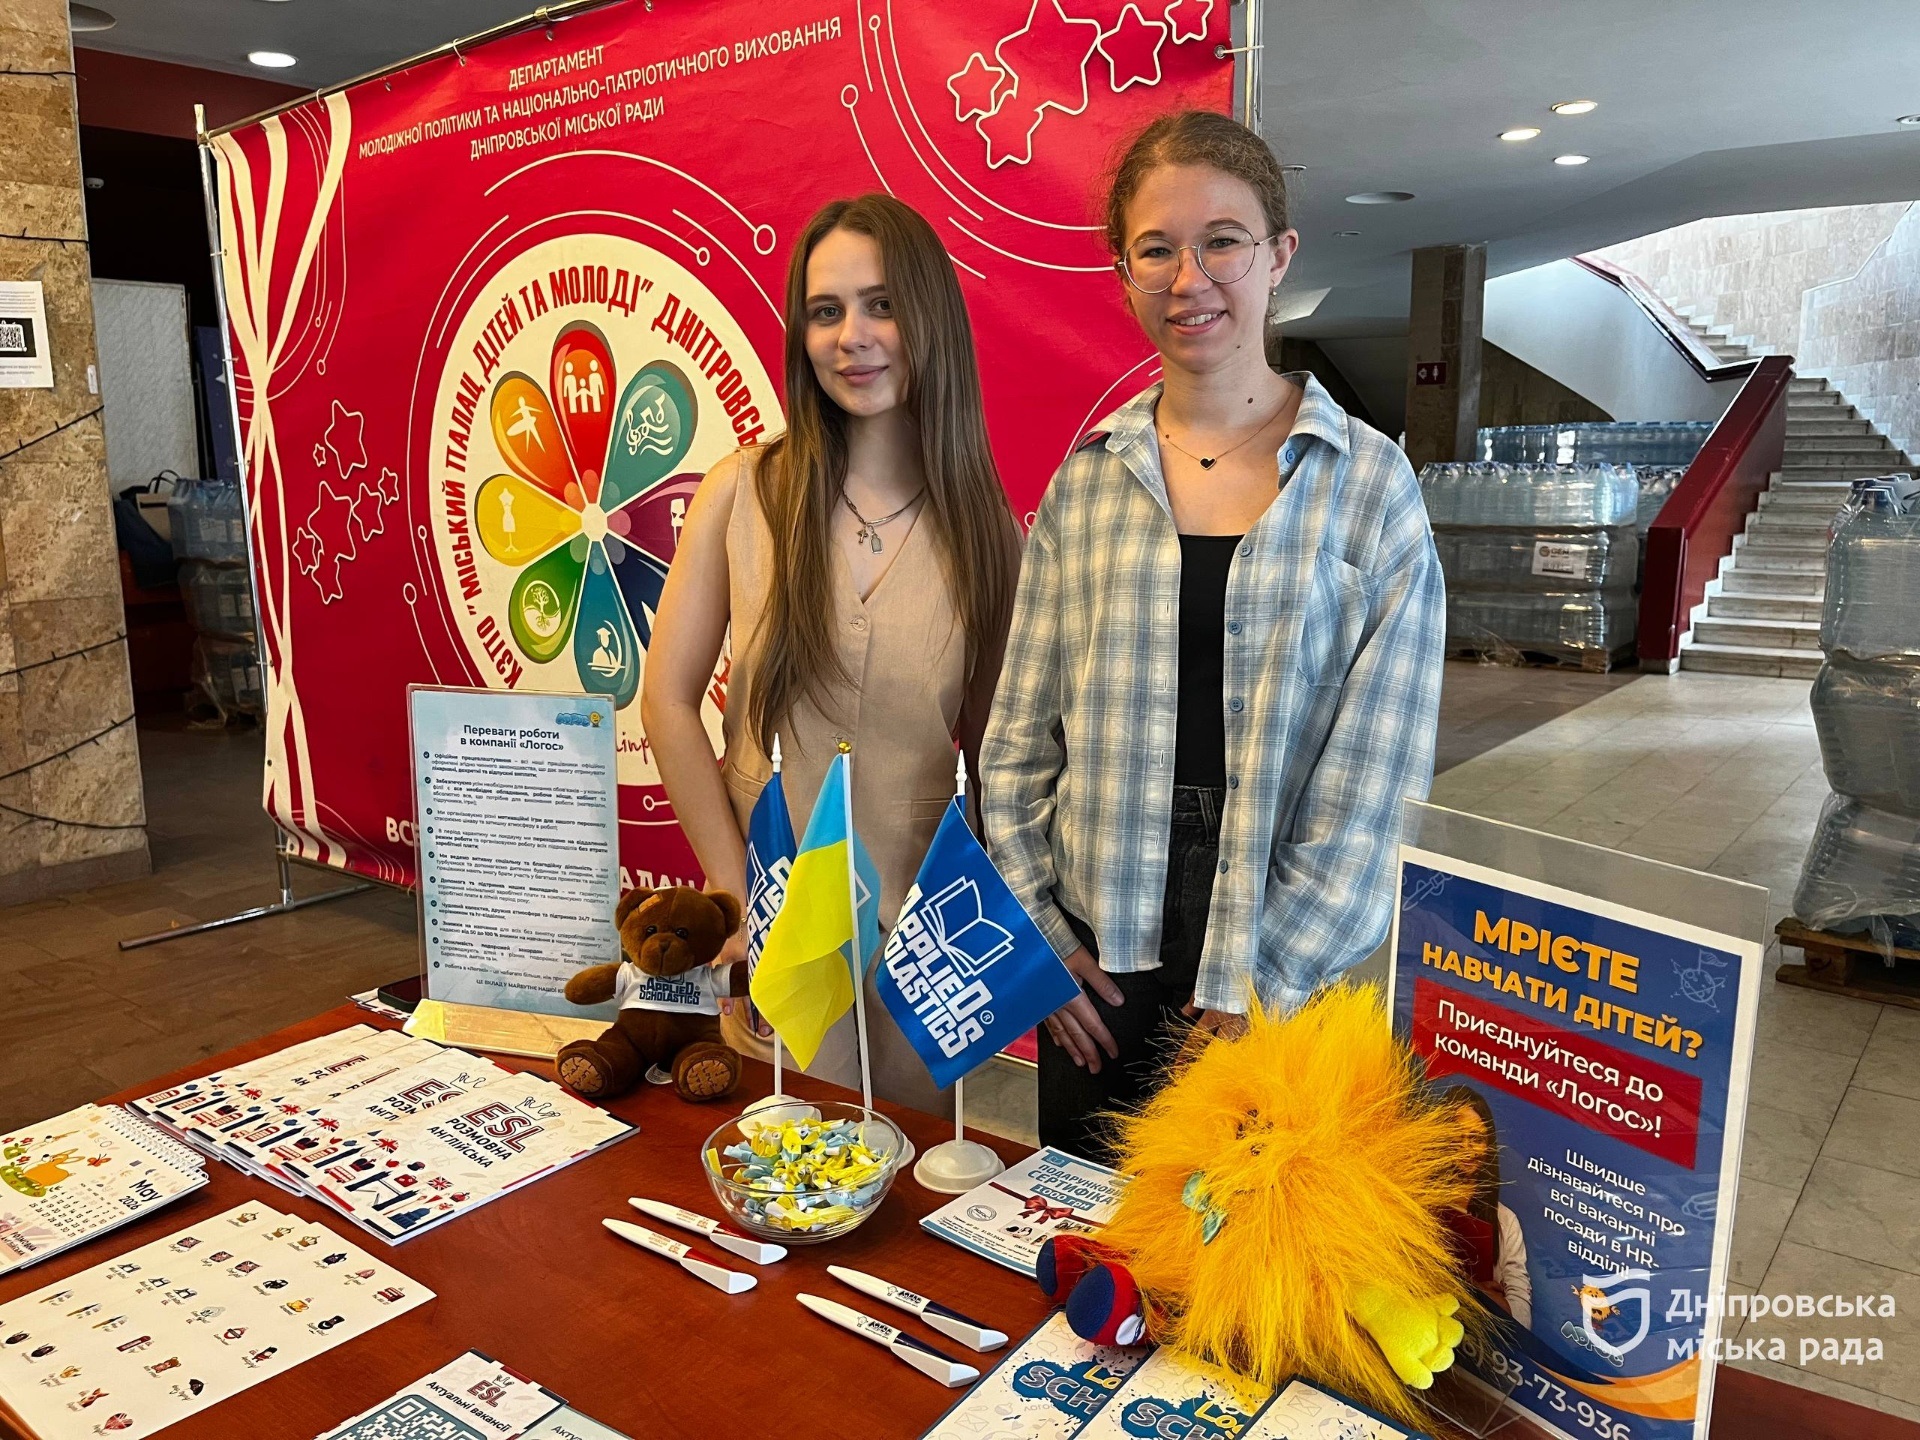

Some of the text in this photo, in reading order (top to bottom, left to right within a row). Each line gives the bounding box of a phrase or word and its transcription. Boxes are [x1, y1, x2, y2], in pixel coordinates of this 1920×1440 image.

[358, 16, 842, 160] МОЛОДІЖНОЇ ПОЛІТИКИ ТА НАЦІОНАЛЬНО-ПАТРІОТИЧНОГО ВИХОВАННЯ
[508, 45, 604, 91] ДЕПАРТАМЕНТ
[470, 96, 665, 162] ДНІПРОВСЬКОЇ МІСЬКОЇ РАДИ
[446, 372, 485, 473] ПАЛАЦ
[473, 293, 523, 385] ДІТЕЙ
[519, 279, 549, 322] ТА
[651, 293, 767, 448] ДНІПРОВСЬ
[463, 724, 560, 740] Переваги роботи
[469, 738, 517, 748] компанії
[519, 740, 564, 751] «Логос»
[1474, 910, 1640, 994] МРІЄТЕ
[639, 985, 701, 1005] SCHOLASTICS
[647, 977, 694, 995] APPLIED
[1422, 942, 1704, 1059] НАВЧАТИ ДІТЕЙ?
[1438, 1000, 1664, 1103] Приєднуйтеся до
[1435, 1033, 1662, 1139] команди «Логос»!
[427, 1126, 494, 1168] АНГЛІЙСЬКА
[445, 1117, 513, 1160] РОЗМОВНА
[460, 1101, 545, 1154] ESL
[129, 1179, 163, 1202] May
[1038, 1164, 1124, 1197] ПОДАРУНКОВИ
[1566, 1149, 1646, 1196] Швидше
[118, 1196, 141, 1210] 2026
[1034, 1186, 1091, 1210] 1000 грн
[1527, 1157, 1685, 1236] дізнавайтеся про
[1551, 1189, 1656, 1247] всі вакантні
[1544, 1207, 1606, 1246] посади
[1611, 1241, 1621, 1253] в
[1568, 1240, 1630, 1279] відділі!
[426, 1381, 512, 1432] Актуальні вакансії
[467, 1380, 507, 1408] ESL
